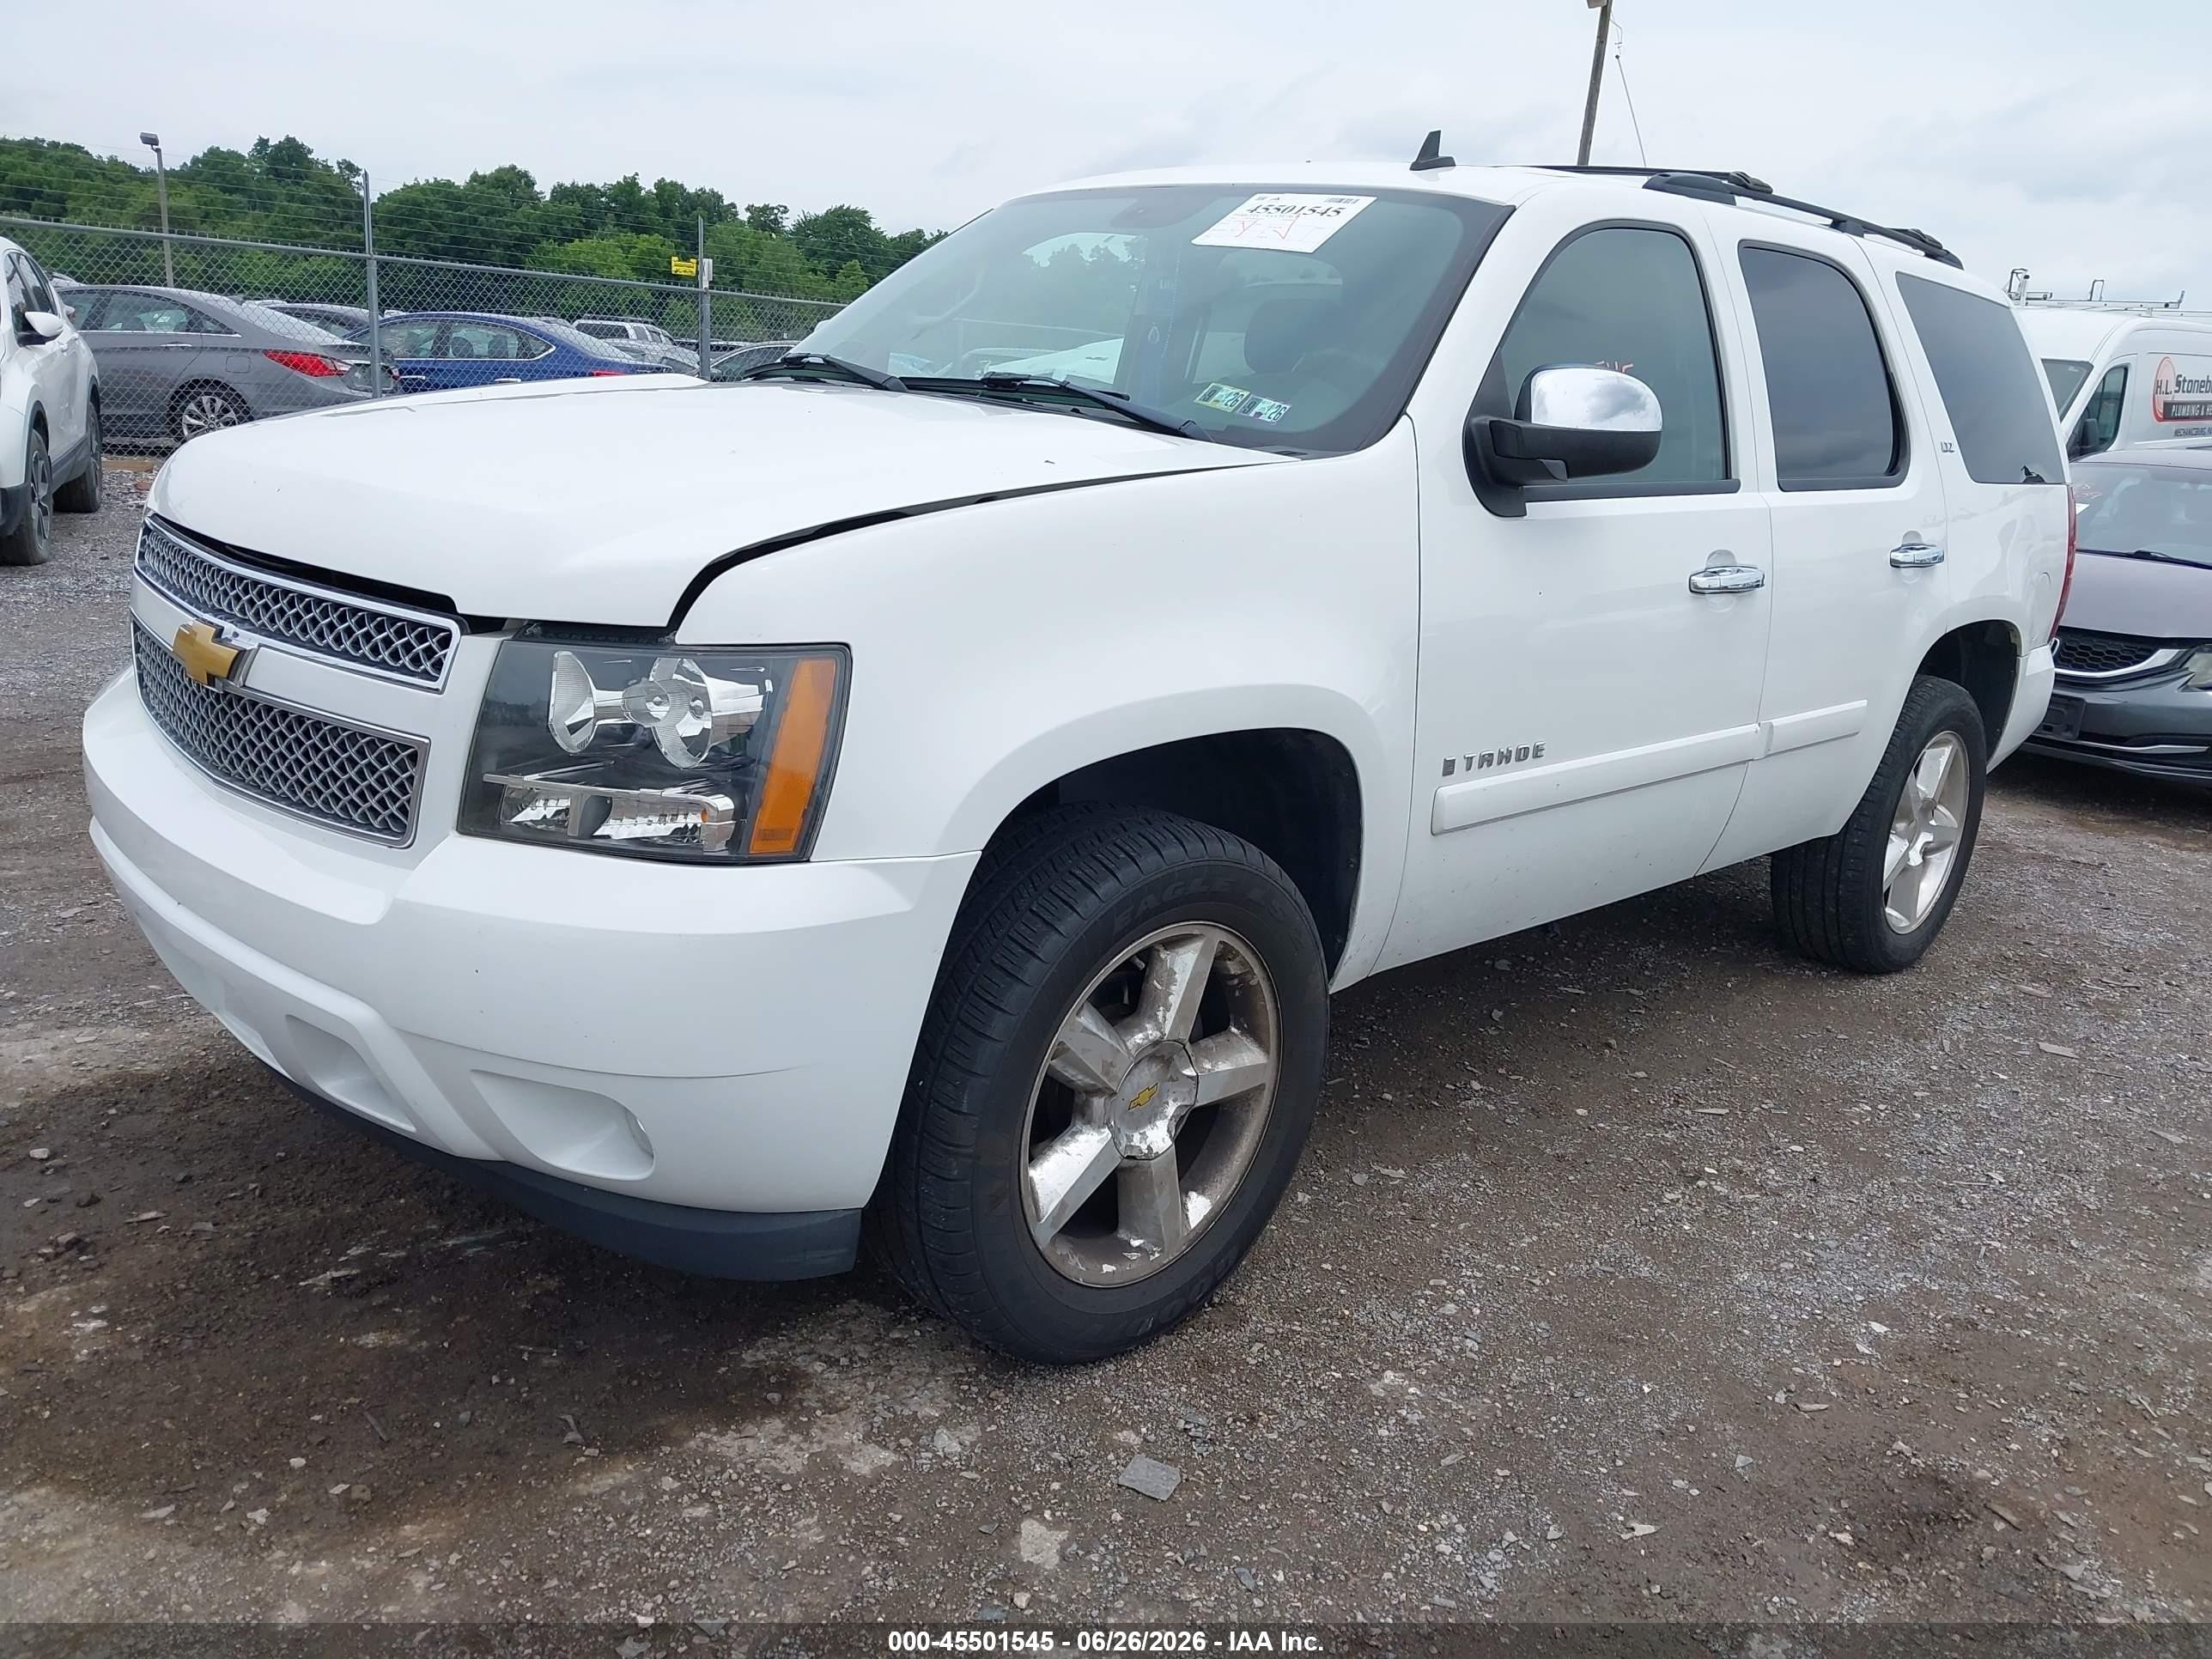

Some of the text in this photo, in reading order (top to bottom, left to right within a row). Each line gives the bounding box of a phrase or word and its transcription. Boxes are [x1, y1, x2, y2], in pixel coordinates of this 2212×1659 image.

[1247, 204, 1346, 217] 45501545
[2155, 374, 2212, 395] H.L. Stoneb
[1224, 392, 1244, 408] 26
[1267, 404, 1287, 421] 26
[1463, 741, 1547, 772] TAHOE
[1114, 872, 1231, 933] EAGLE
